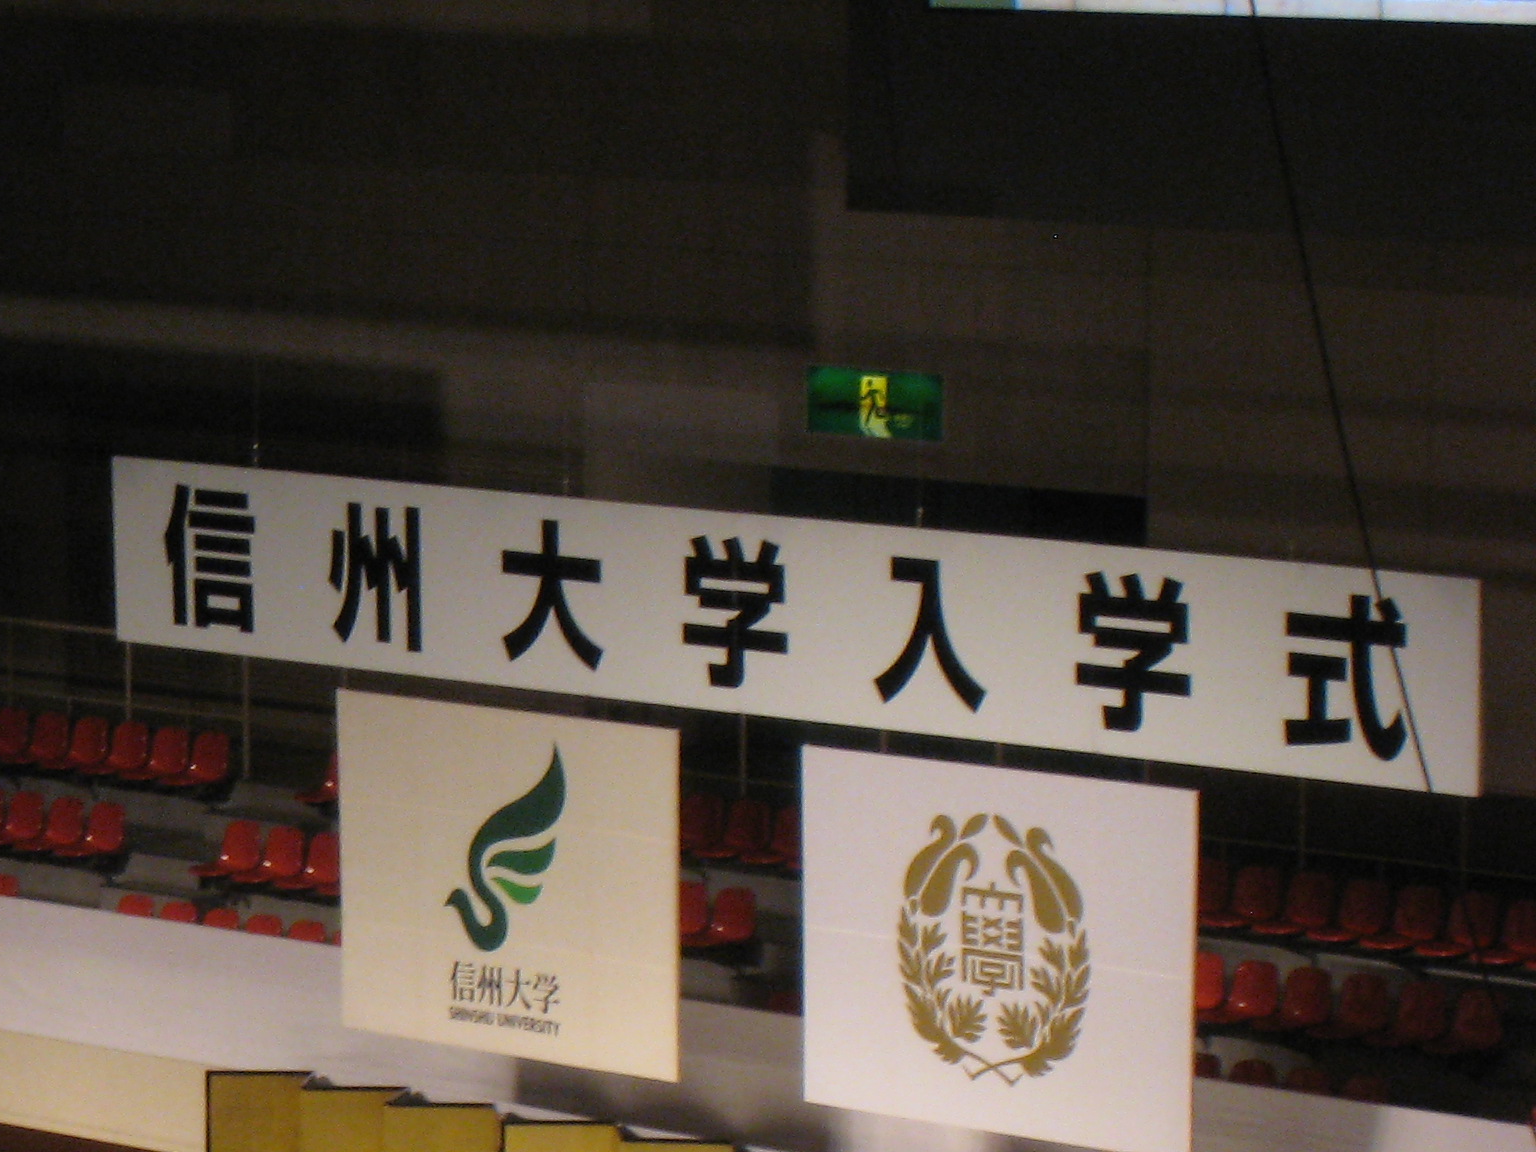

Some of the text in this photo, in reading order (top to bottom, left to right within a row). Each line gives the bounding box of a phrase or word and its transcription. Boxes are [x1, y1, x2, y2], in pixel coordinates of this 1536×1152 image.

[164, 483, 1408, 763] 信州大学入学式
[451, 961, 560, 1014] 信州大学
